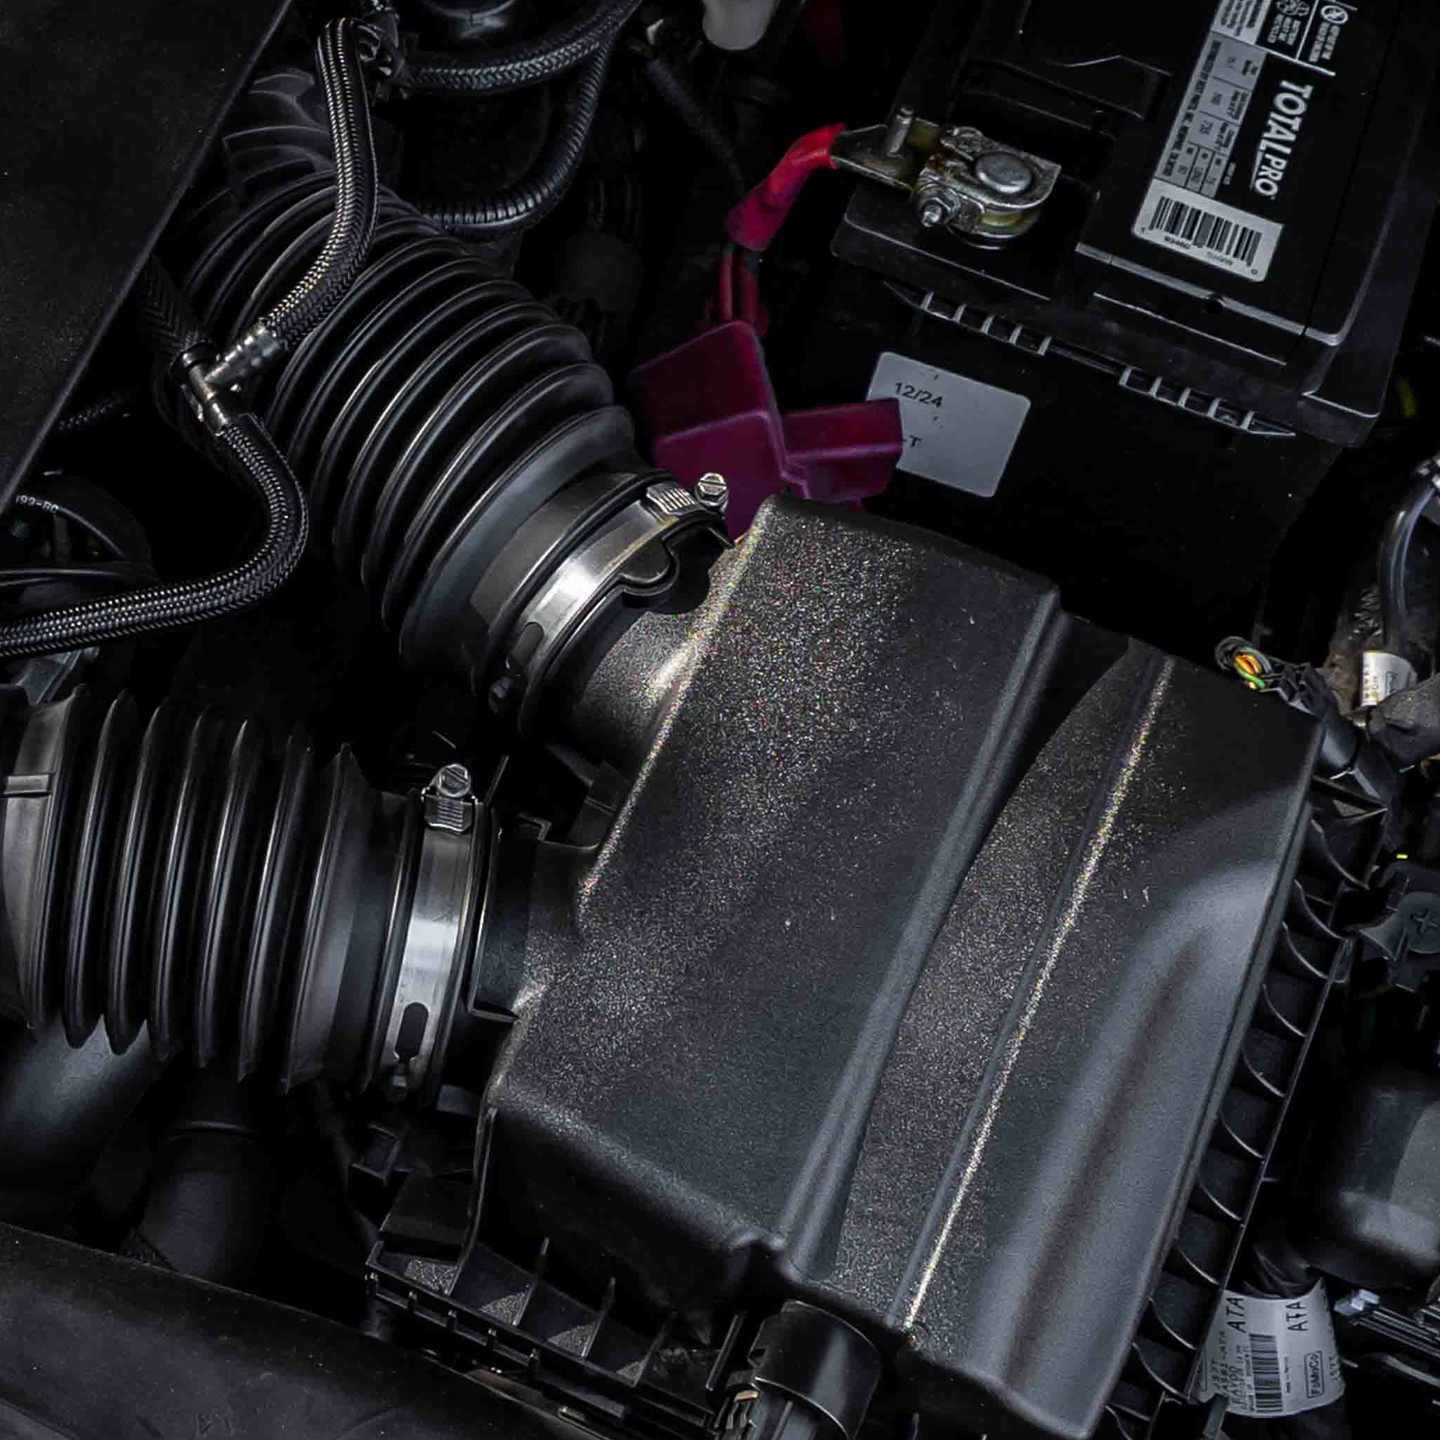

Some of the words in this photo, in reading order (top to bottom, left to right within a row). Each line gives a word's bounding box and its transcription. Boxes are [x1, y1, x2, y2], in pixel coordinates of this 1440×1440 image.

[1252, 81, 1312, 199] TOTALPRO
[894, 380, 944, 408] 12/24
[1226, 1296, 1247, 1333] ATA
[1286, 1301, 1309, 1331] ATA
